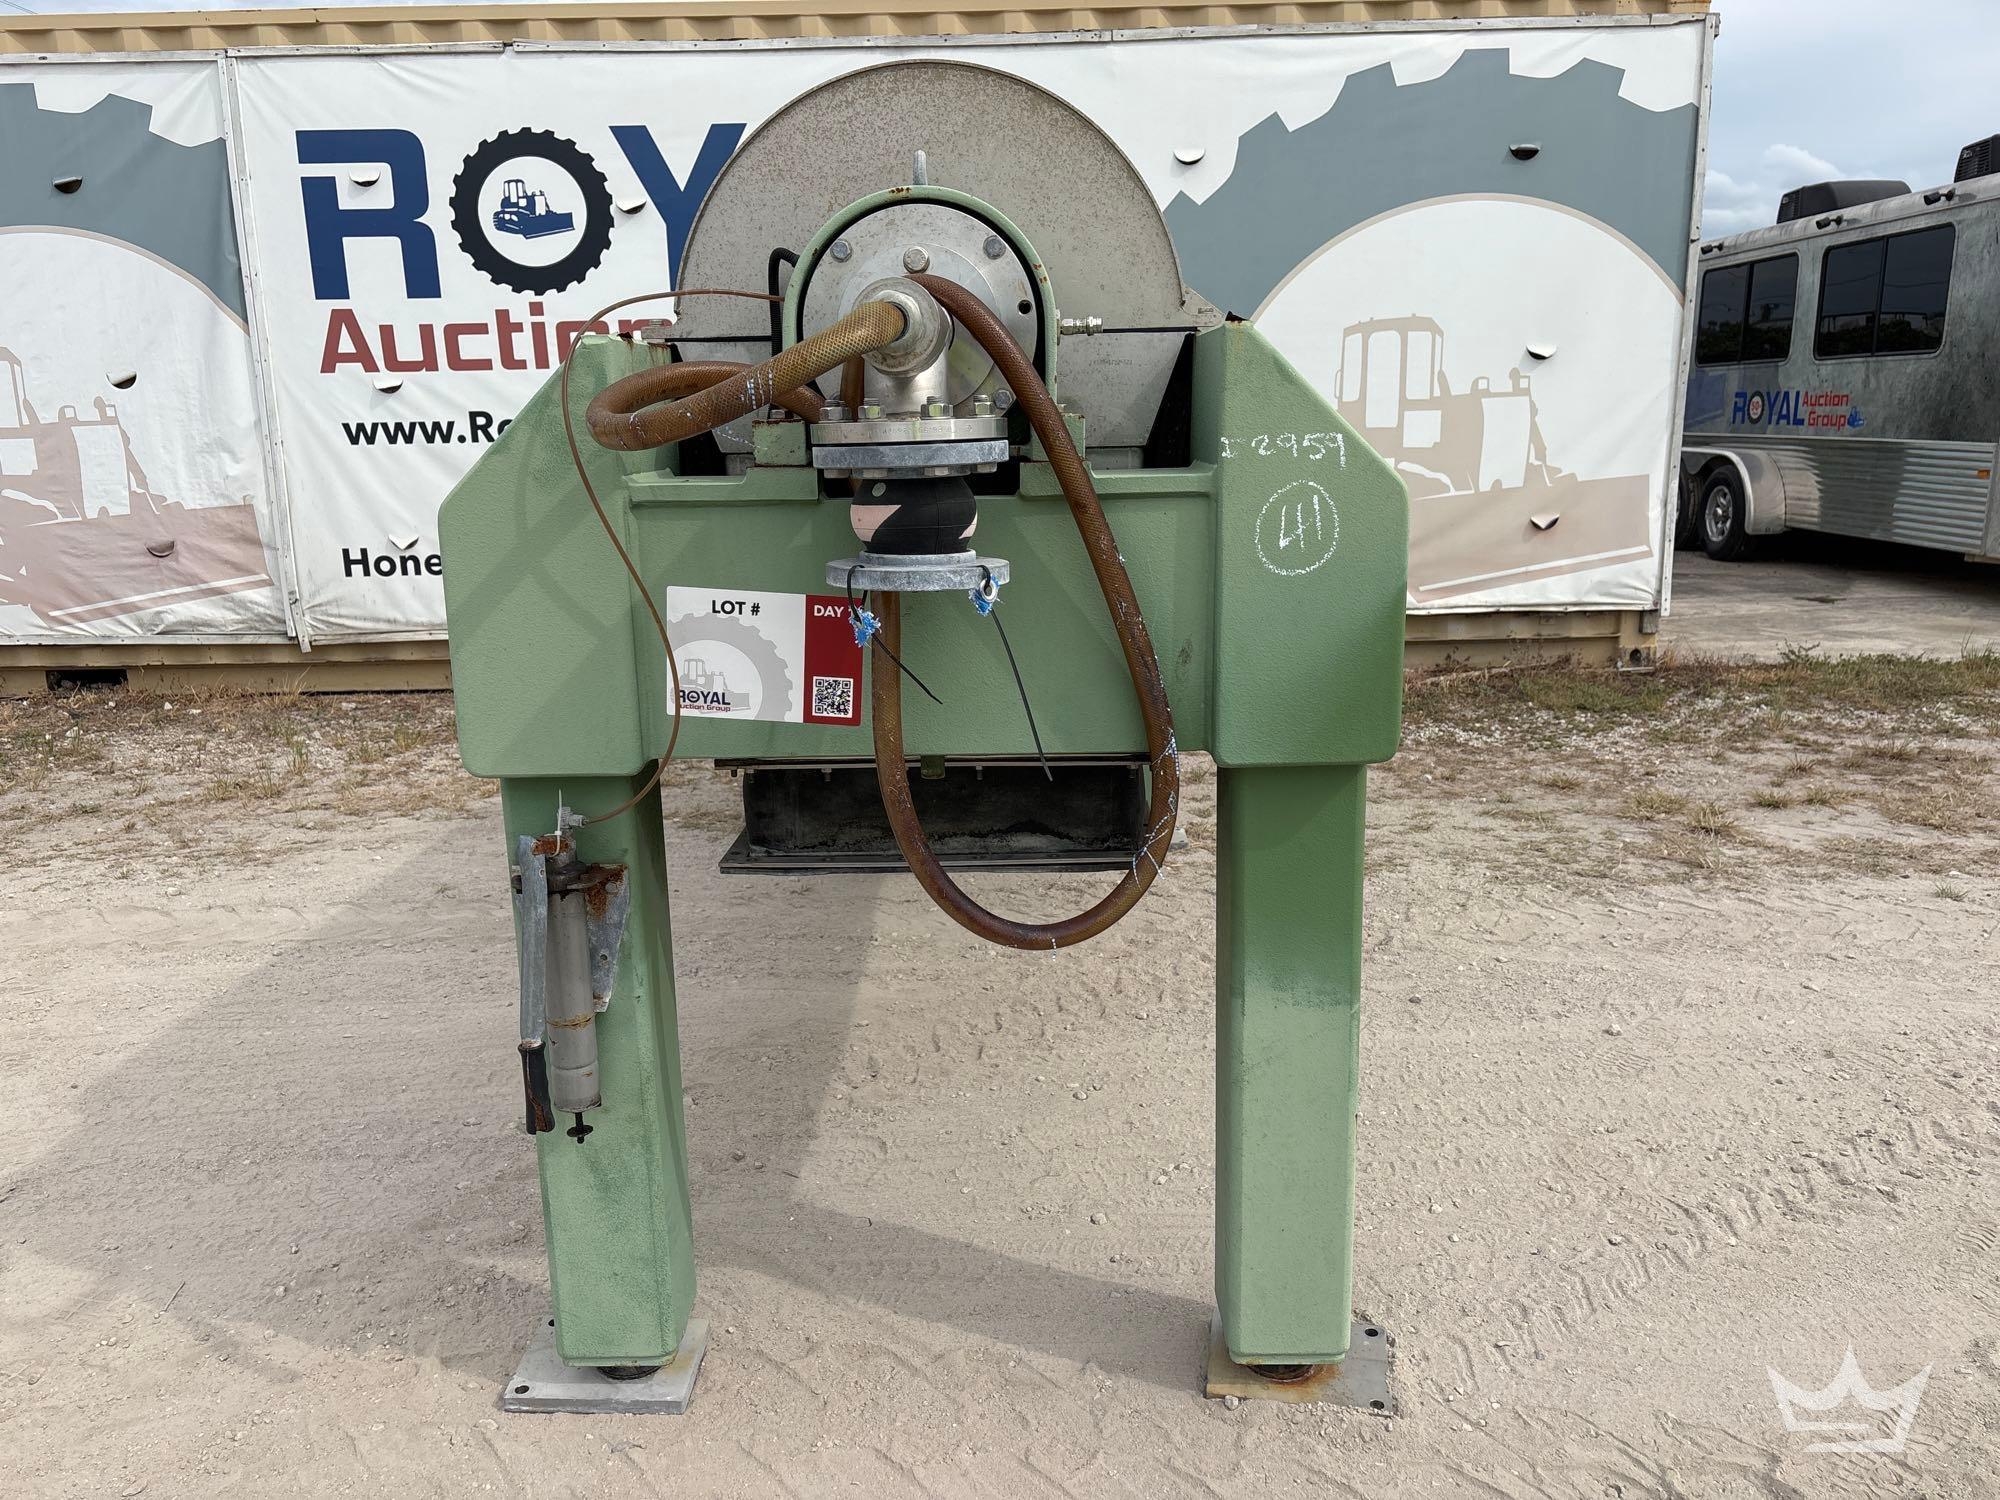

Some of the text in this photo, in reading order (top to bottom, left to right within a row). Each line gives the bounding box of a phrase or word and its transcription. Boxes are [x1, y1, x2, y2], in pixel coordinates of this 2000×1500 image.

[1802, 390, 1849, 408] Auction
[1732, 390, 1805, 426] ROYAL
[1808, 409, 1847, 432] Group
[712, 599, 761, 616] LOT #
[813, 604, 845, 618] DAY
[680, 703, 731, 713] uction Group
